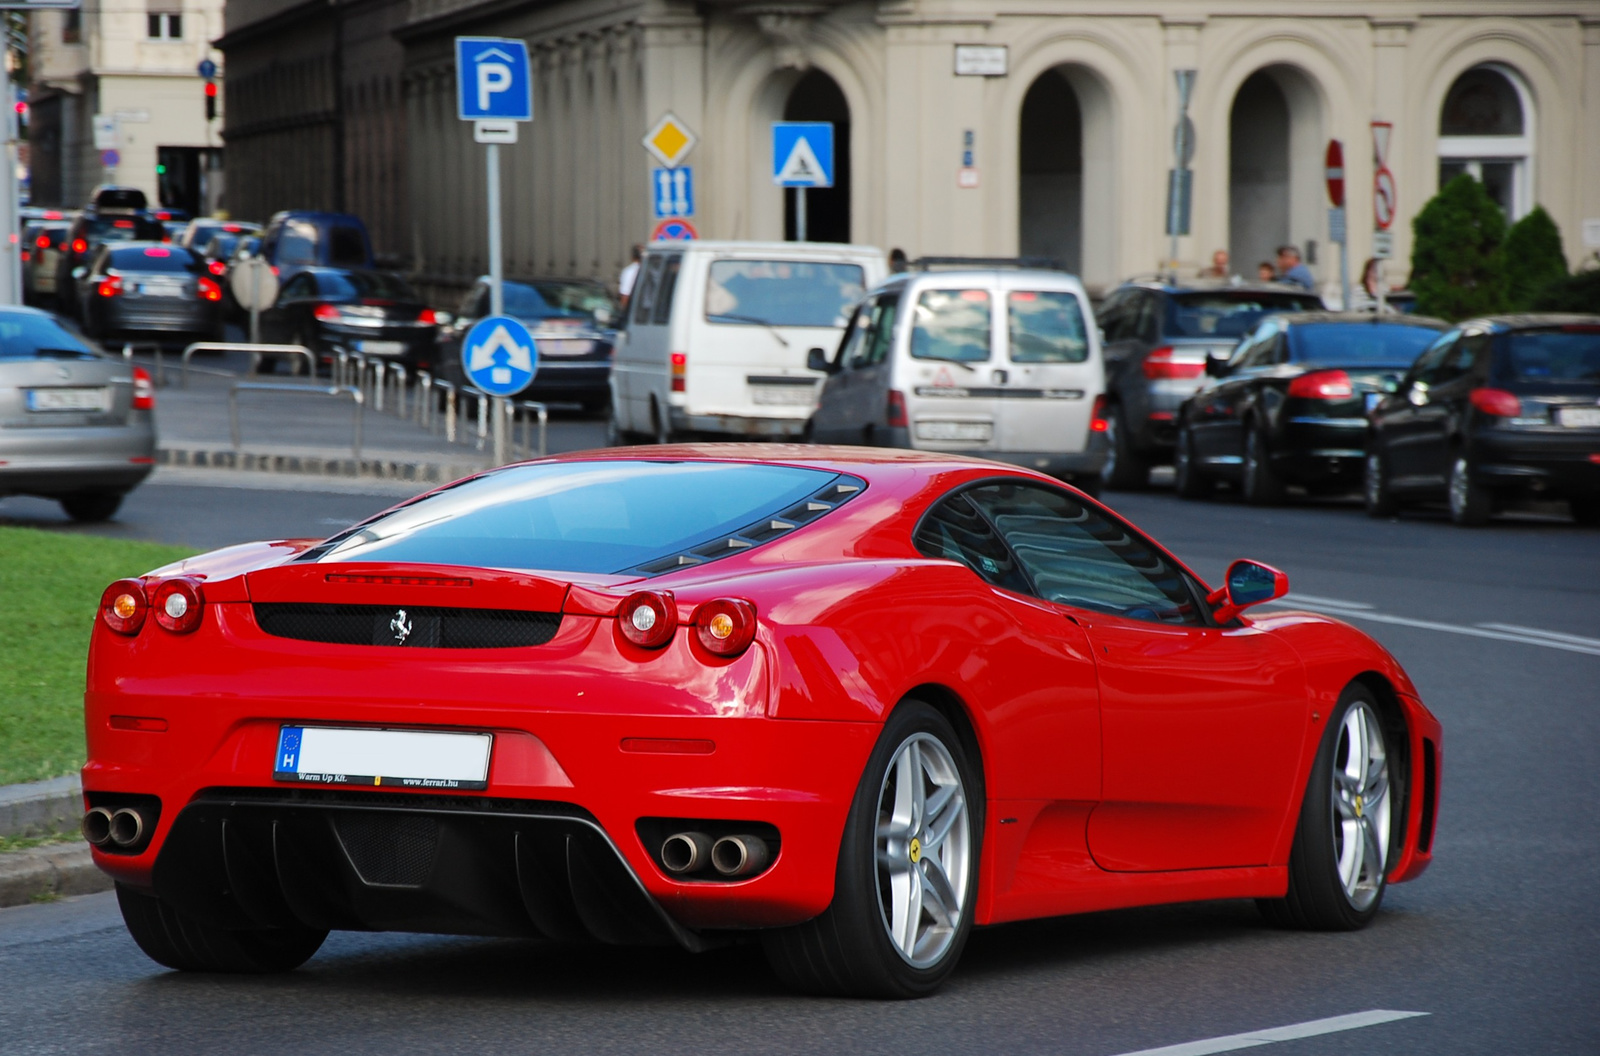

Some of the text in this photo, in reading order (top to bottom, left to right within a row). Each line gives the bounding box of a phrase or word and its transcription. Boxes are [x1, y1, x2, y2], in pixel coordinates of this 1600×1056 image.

[476, 62, 511, 111] P
[283, 754, 295, 767] H
[298, 773, 348, 783] Warm Up Kft.
[403, 778, 458, 788] www.ferrari.hu
